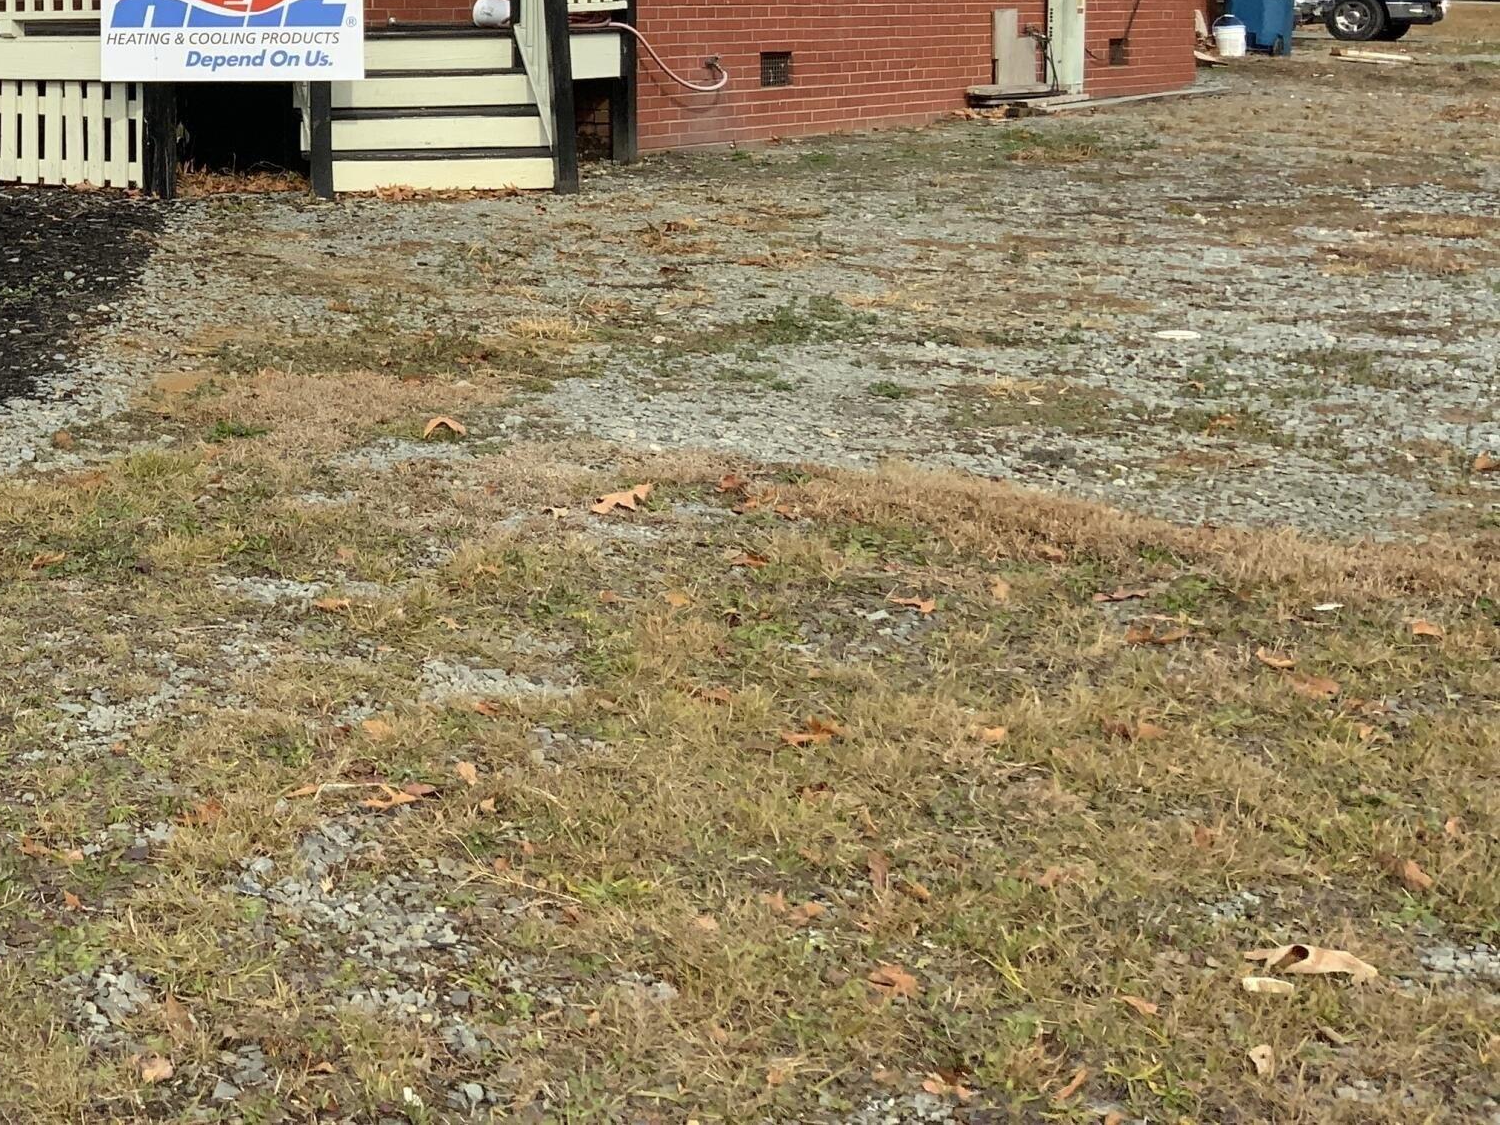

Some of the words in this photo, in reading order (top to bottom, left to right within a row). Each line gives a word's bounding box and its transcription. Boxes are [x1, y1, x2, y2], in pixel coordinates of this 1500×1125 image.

[106, 32, 171, 45] HEATING
[174, 32, 185, 44] &
[189, 31, 256, 44] COOLING
[261, 31, 340, 44] PRODUCTS
[185, 49, 267, 72] Depend
[270, 49, 300, 67] On
